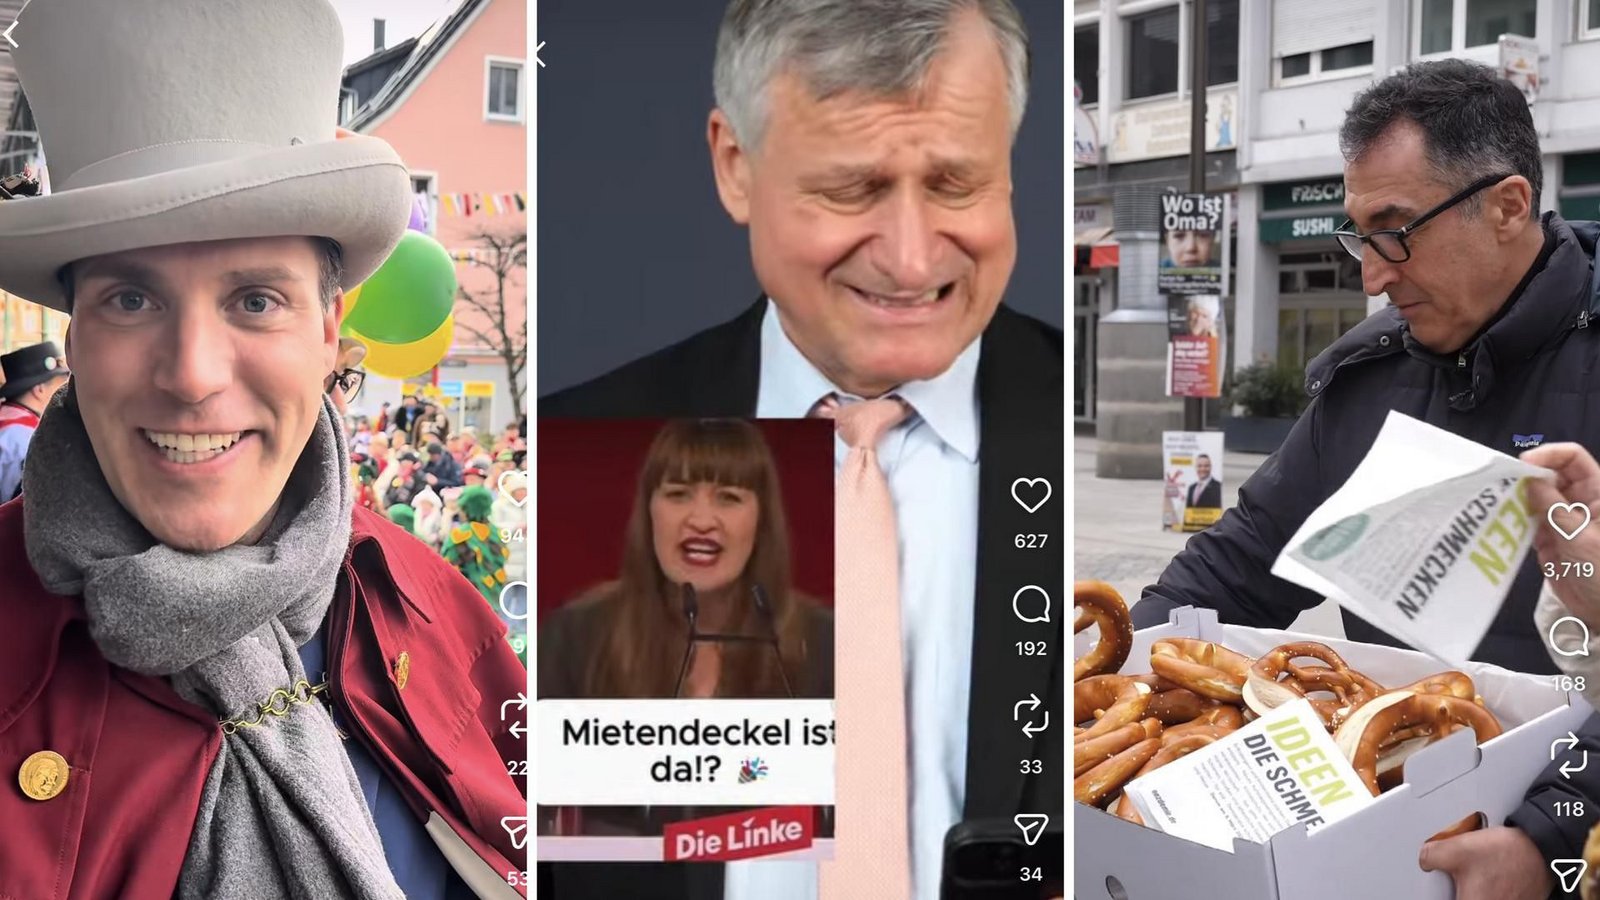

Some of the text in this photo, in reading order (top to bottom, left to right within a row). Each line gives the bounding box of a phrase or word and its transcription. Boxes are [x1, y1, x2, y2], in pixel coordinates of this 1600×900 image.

[1162, 194, 1222, 213] Wo ist
[1164, 212, 1219, 230] Oma?
[1292, 217, 1334, 236] SUSHI
[1396, 488, 1497, 620] SCHMECKEN
[1243, 733, 1279, 767] DIE
[1266, 716, 1355, 808] IDEEN
[675, 817, 803, 860] Die Linke
